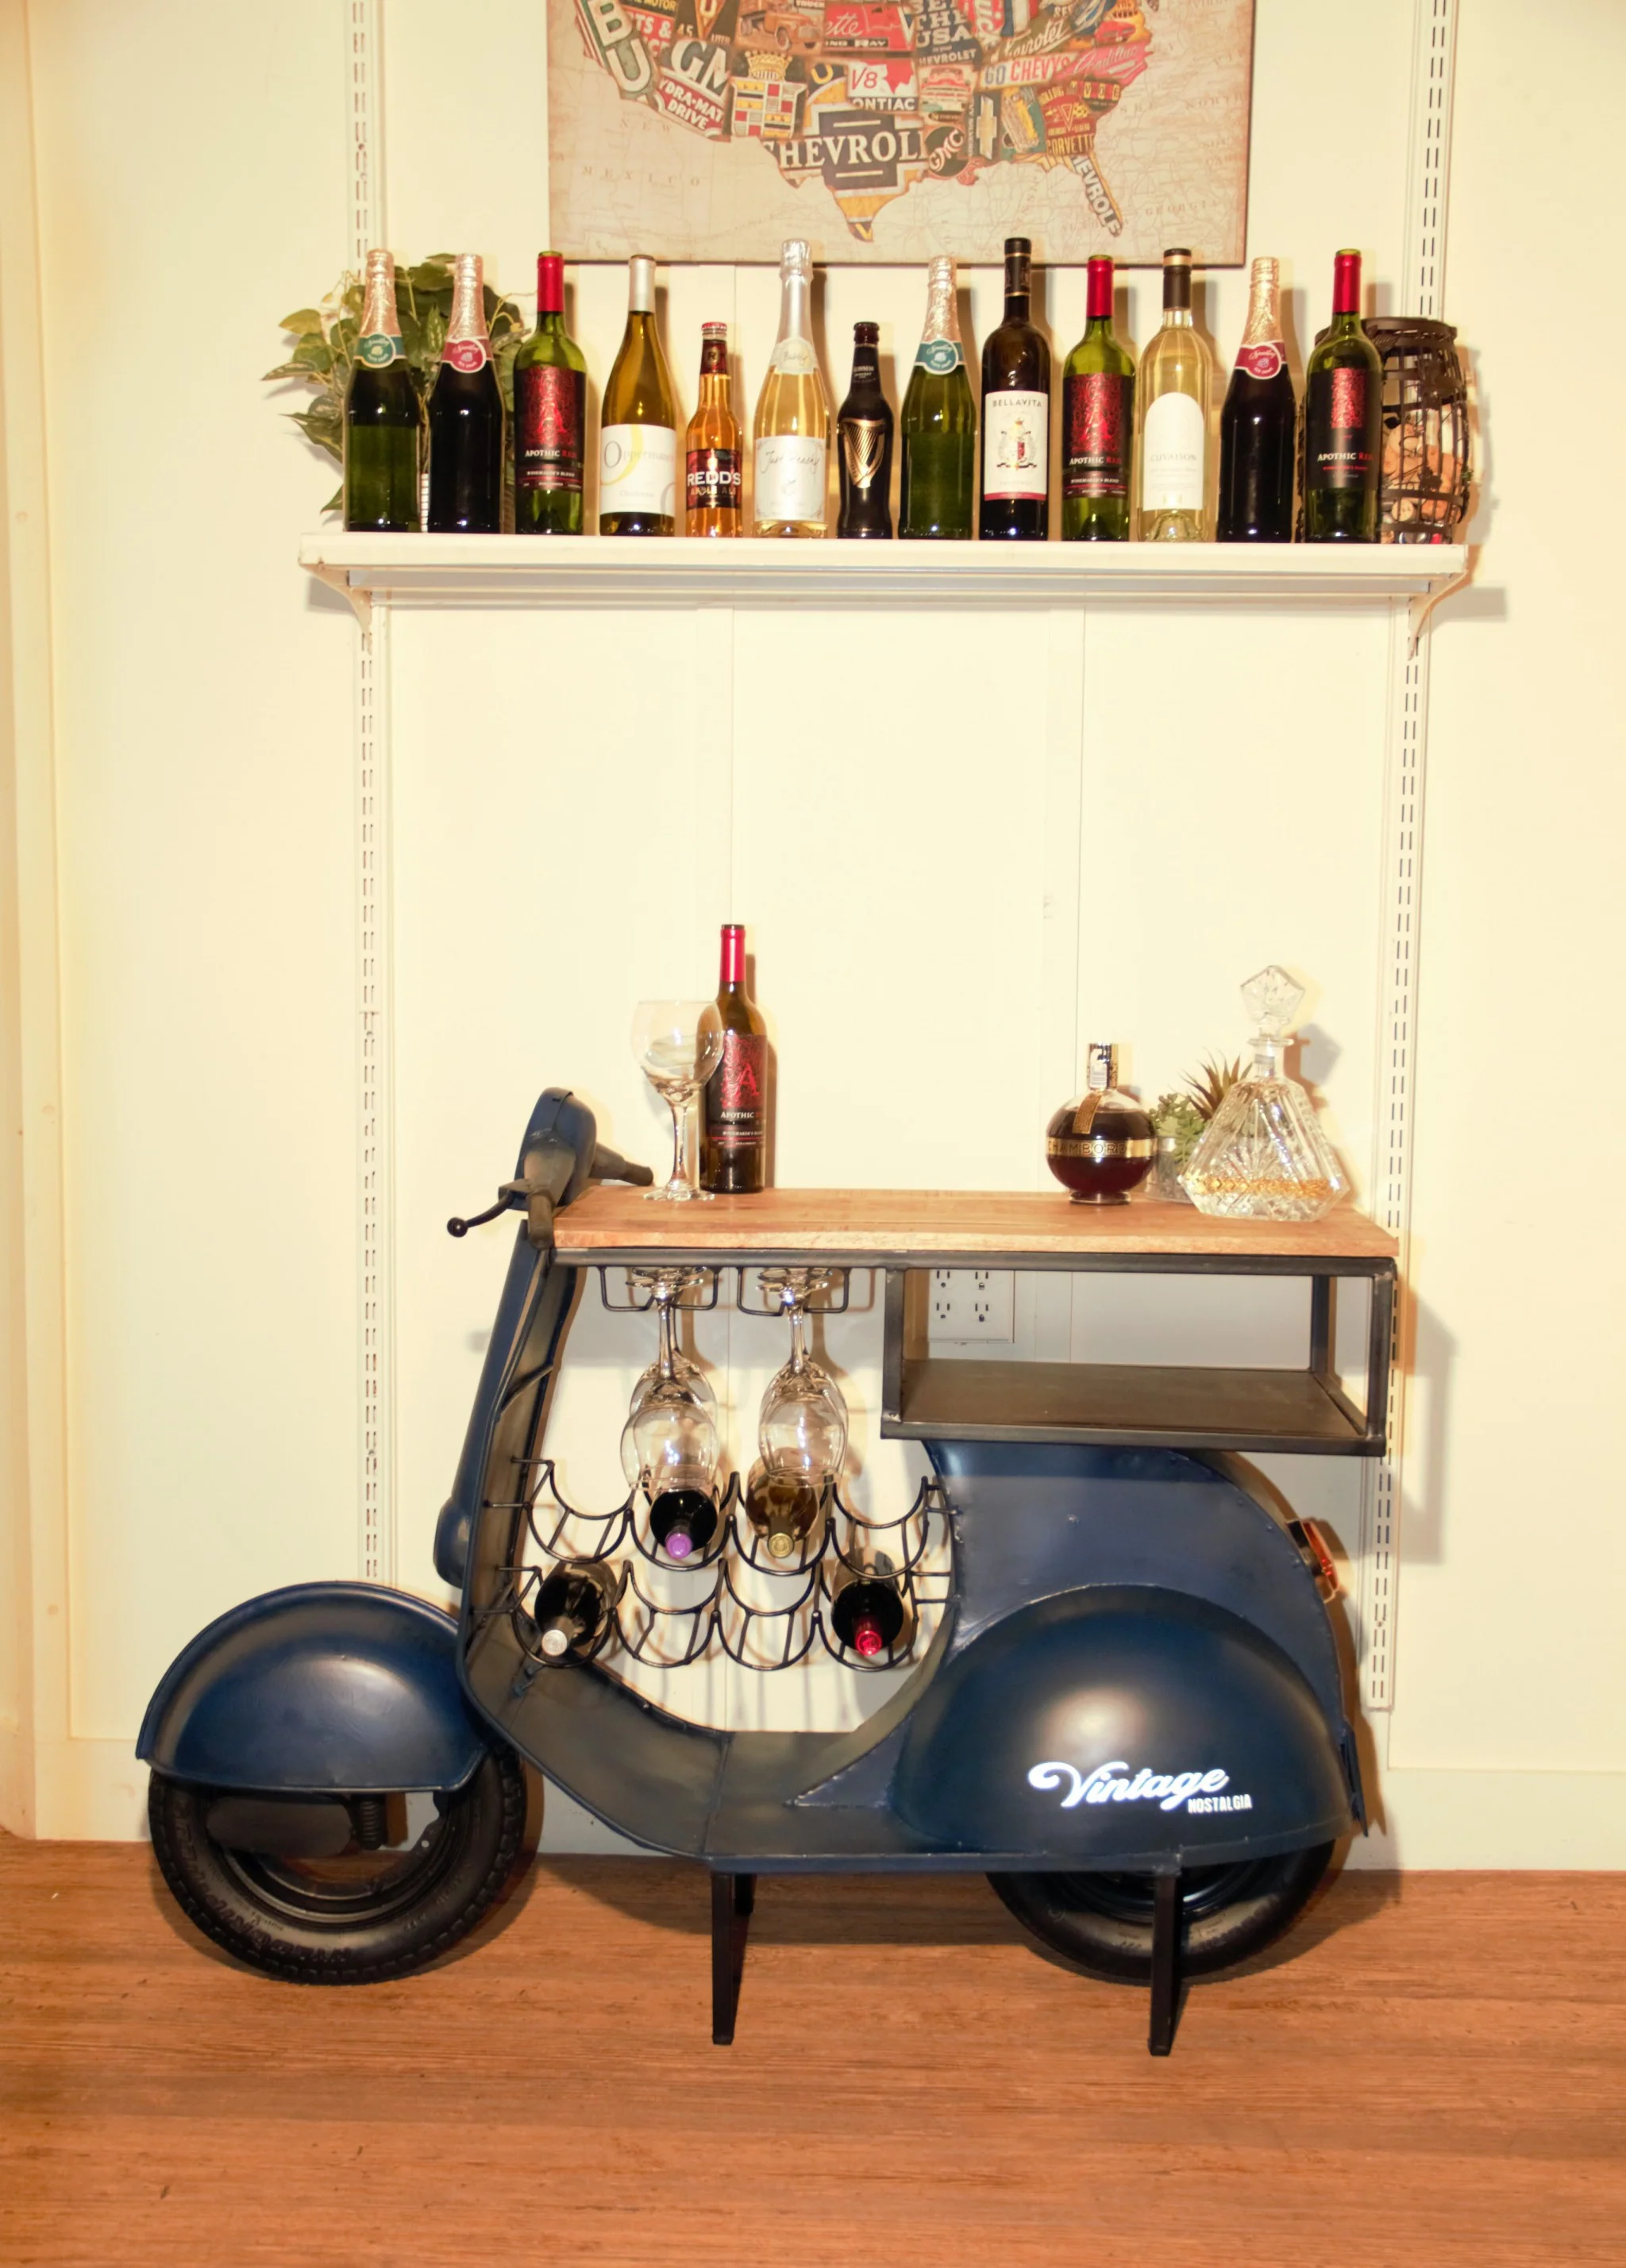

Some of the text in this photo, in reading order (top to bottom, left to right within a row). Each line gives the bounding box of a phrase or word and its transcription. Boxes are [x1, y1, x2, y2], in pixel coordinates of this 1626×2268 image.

[915, 25, 973, 48] USA
[851, 66, 878, 90] V8
[984, 64, 1007, 85] GO
[668, 98, 709, 130] DRIVE
[929, 129, 965, 172] GMC
[992, 399, 1042, 407] BELLAVITA
[1069, 456, 1104, 465] APOTHIC
[1318, 452, 1356, 461] APOTHIC
[1028, 1761, 1230, 1811] Vintage
[1188, 1794, 1252, 1813] NOSTALGIA
